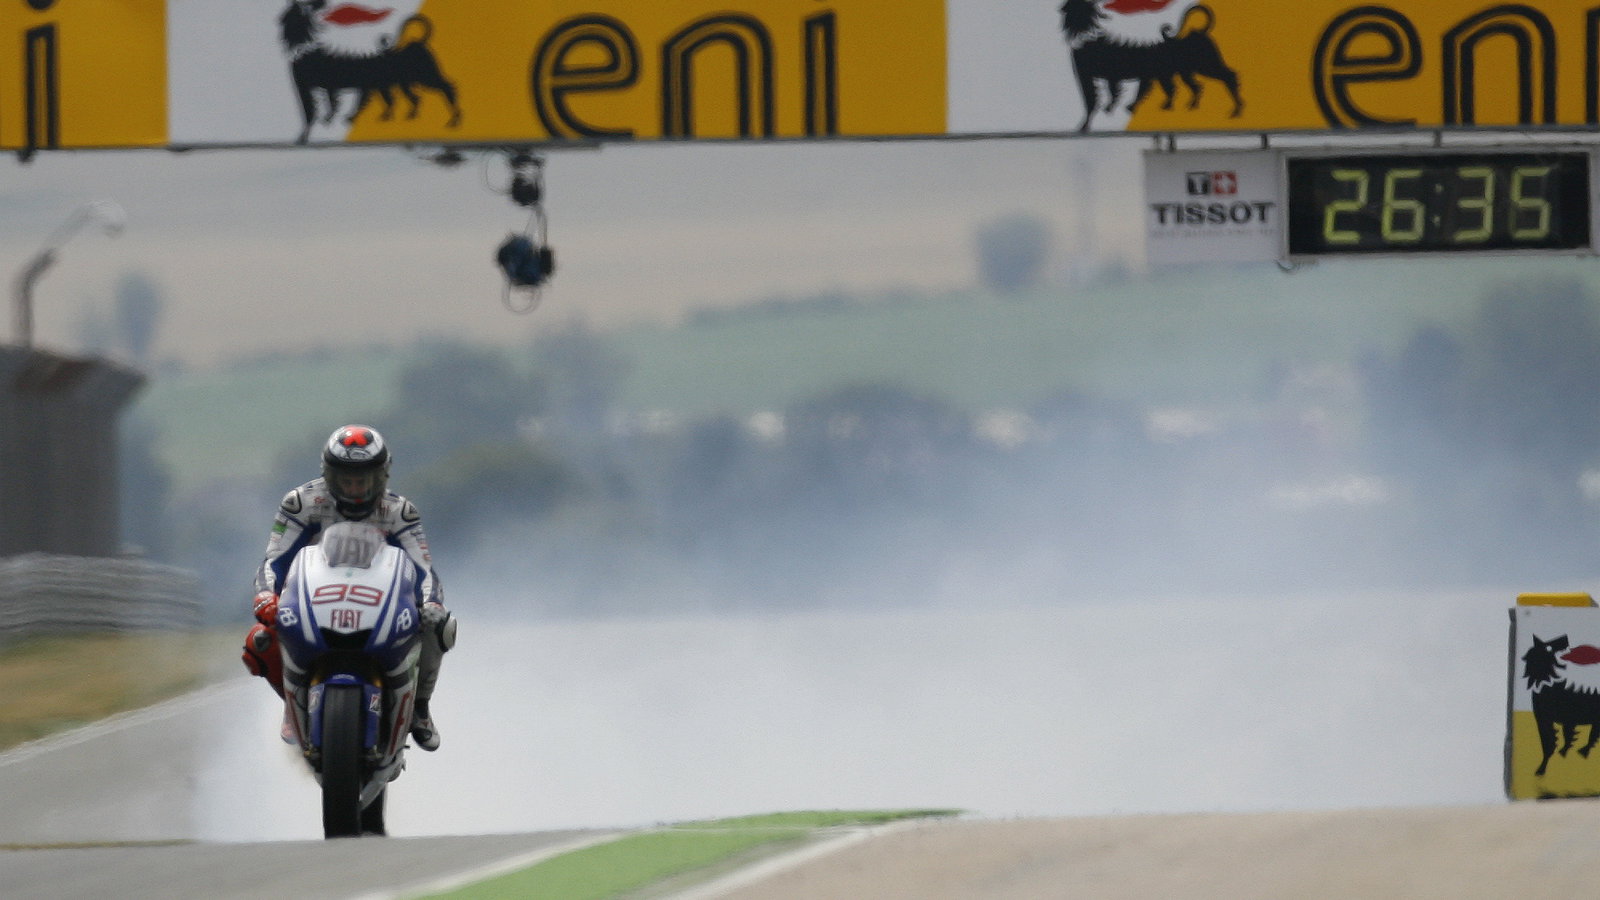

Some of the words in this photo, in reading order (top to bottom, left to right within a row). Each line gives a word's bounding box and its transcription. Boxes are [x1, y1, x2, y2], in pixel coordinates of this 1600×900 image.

[530, 0, 838, 139] eni
[1151, 201, 1275, 225] TISSOT
[1323, 166, 1551, 244] 26:35
[312, 584, 385, 608] 99
[330, 609, 363, 630] FIAT
